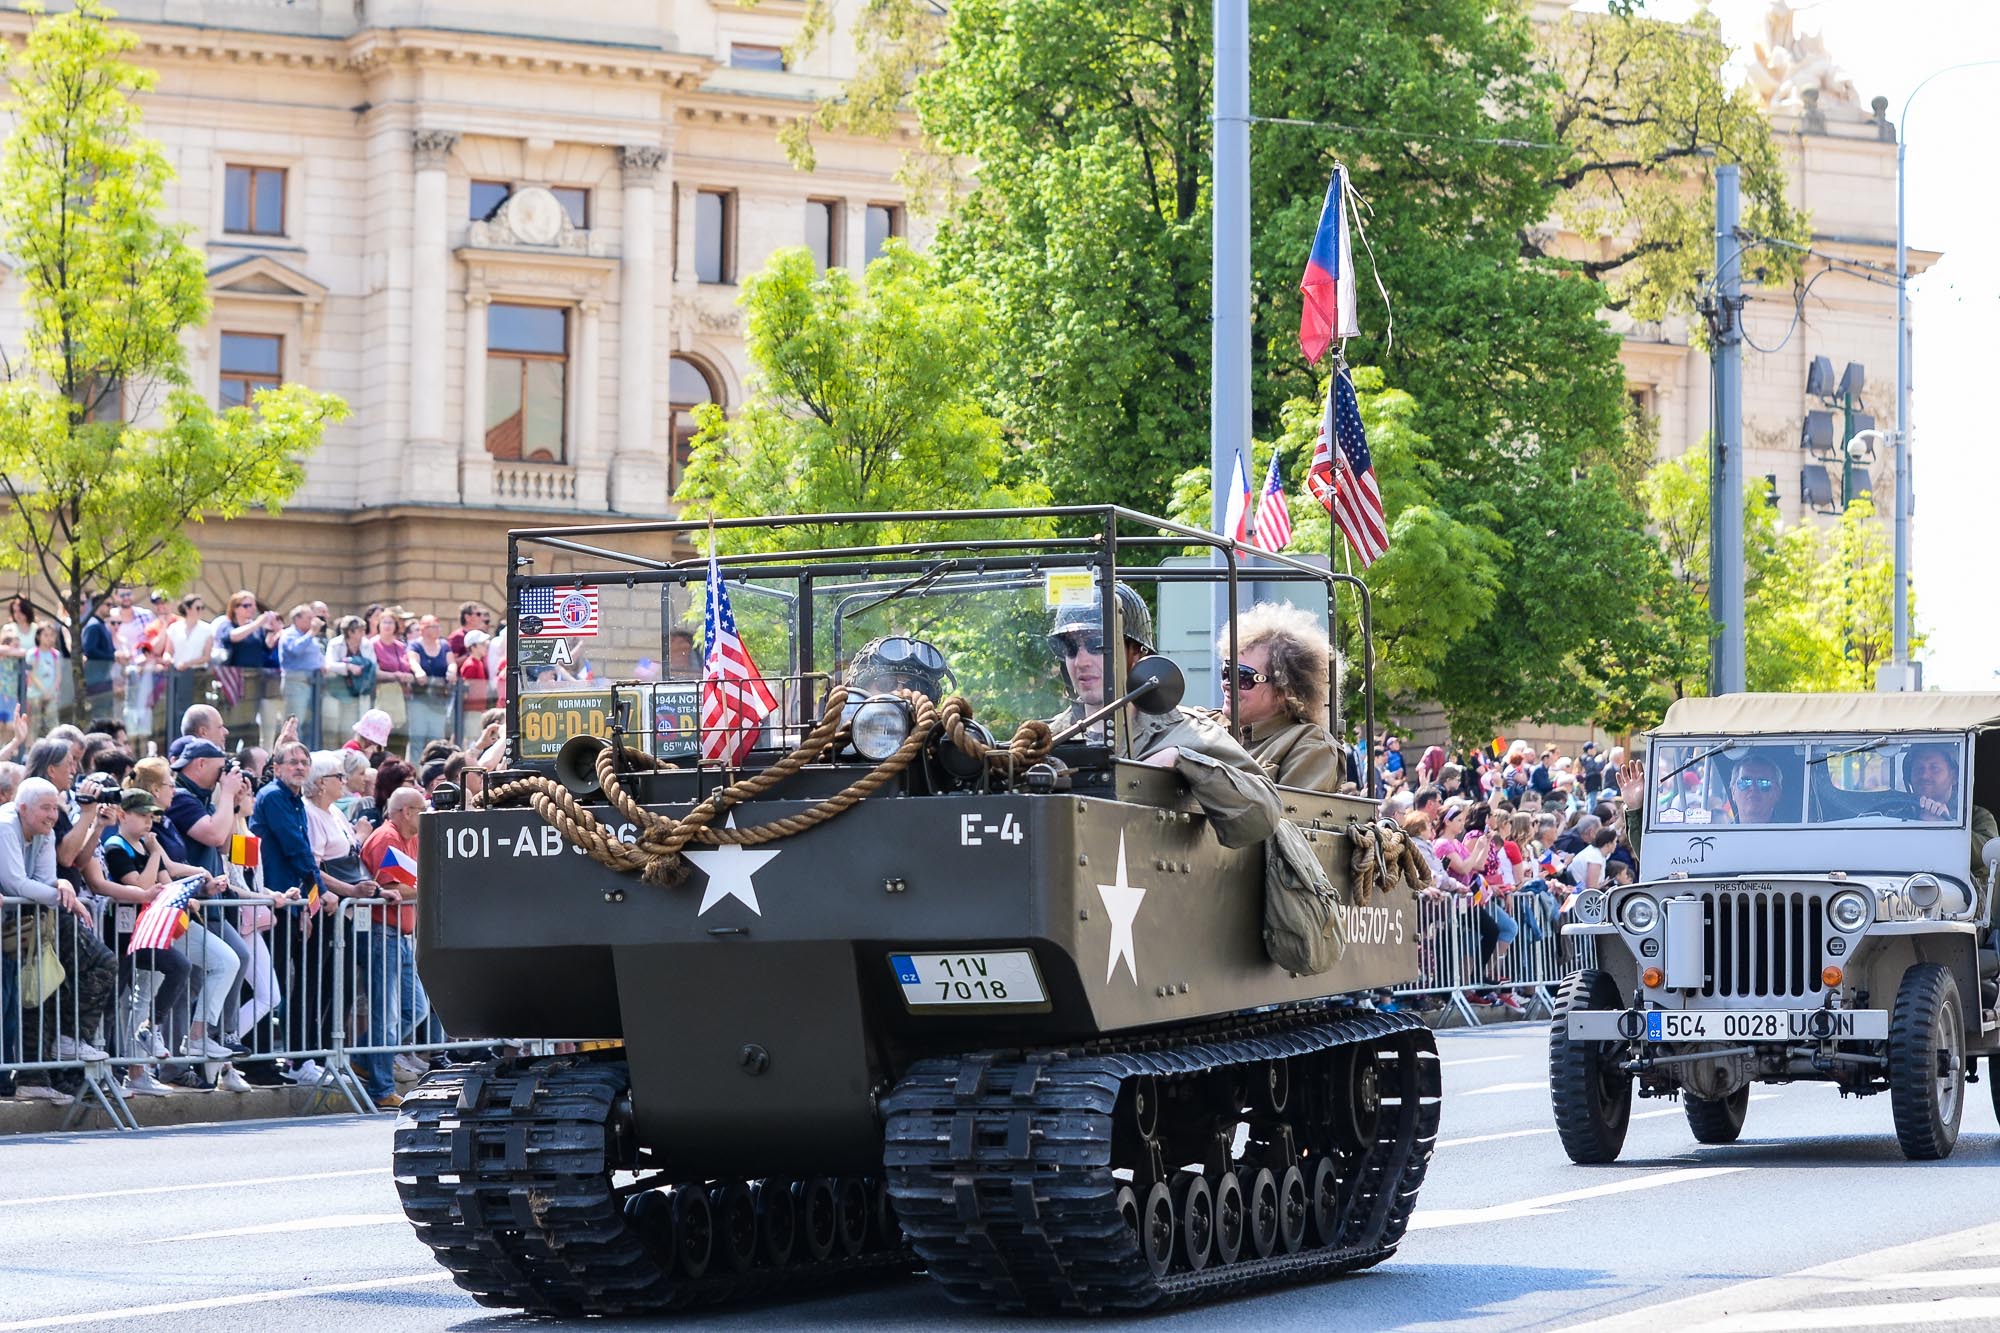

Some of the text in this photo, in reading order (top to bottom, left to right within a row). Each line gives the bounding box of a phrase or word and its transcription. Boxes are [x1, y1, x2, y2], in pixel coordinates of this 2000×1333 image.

[550, 638, 572, 664] A
[557, 698, 602, 709] NORMANDY
[541, 743, 564, 753] OVER
[663, 741, 682, 751] 65TH
[961, 813, 1024, 846] E-4
[1670, 856, 1699, 865] Aloha
[1714, 882, 1773, 892] PRESTONE-44
[939, 957, 988, 978] 11V
[902, 973, 918, 982] CZ
[935, 980, 1008, 1001] 7018
[1650, 1015, 1777, 1038] CZ 5C4 0028
